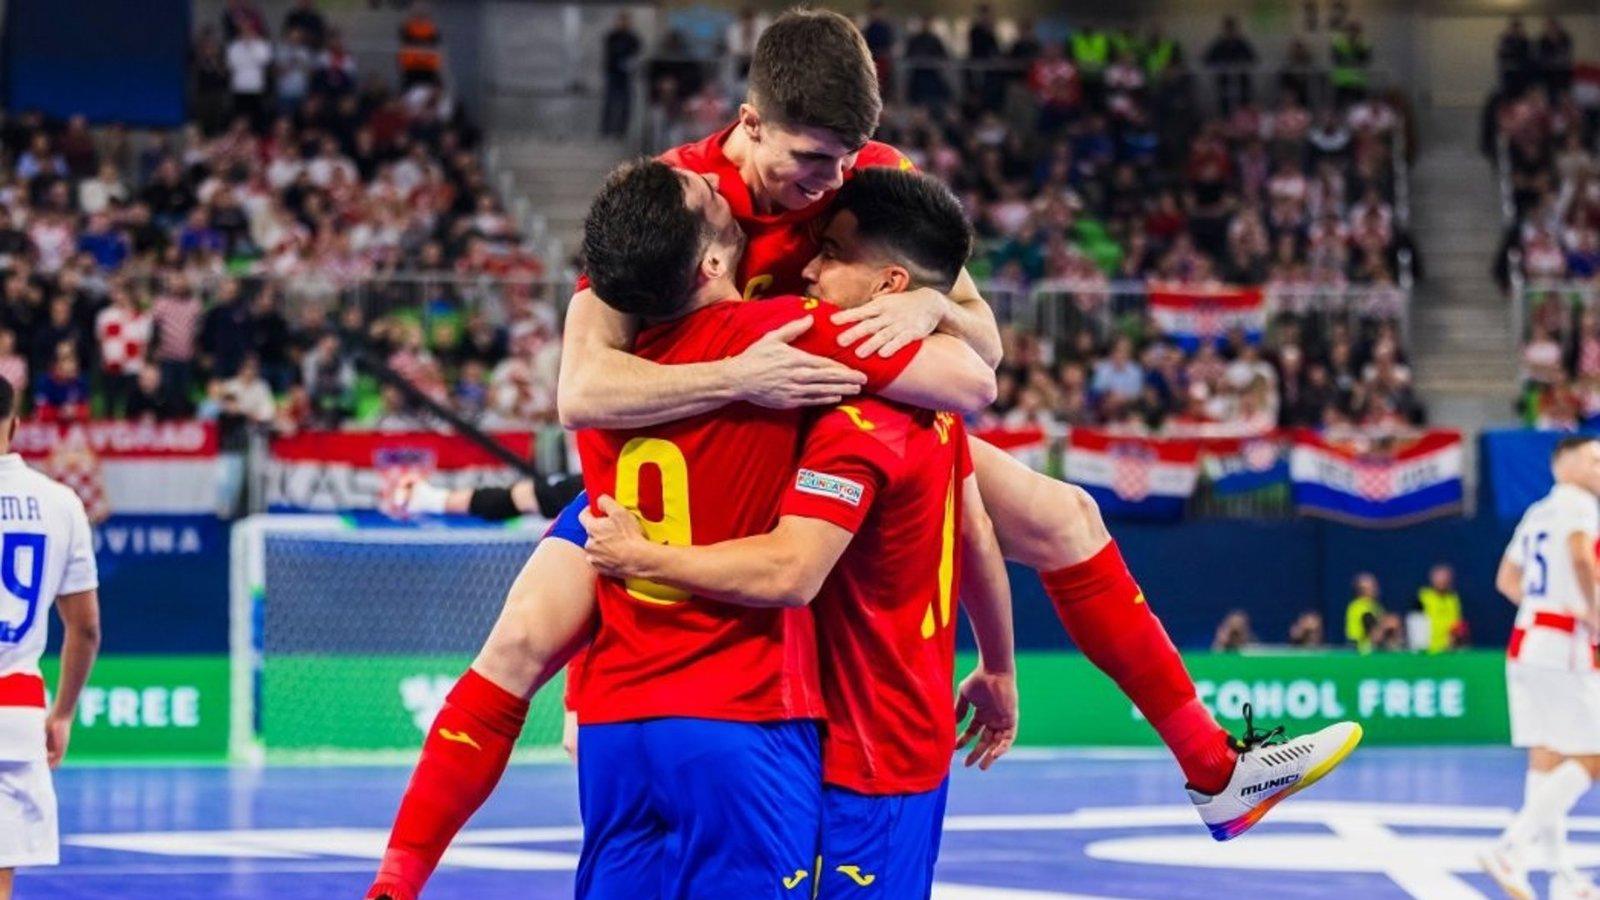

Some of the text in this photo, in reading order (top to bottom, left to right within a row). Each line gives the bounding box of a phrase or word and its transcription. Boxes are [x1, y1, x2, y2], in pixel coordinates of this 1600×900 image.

[615, 437, 693, 605] 9
[1523, 533, 1547, 594] 15
[80, 687, 199, 727] FREE
[1358, 680, 1463, 717] FREE
